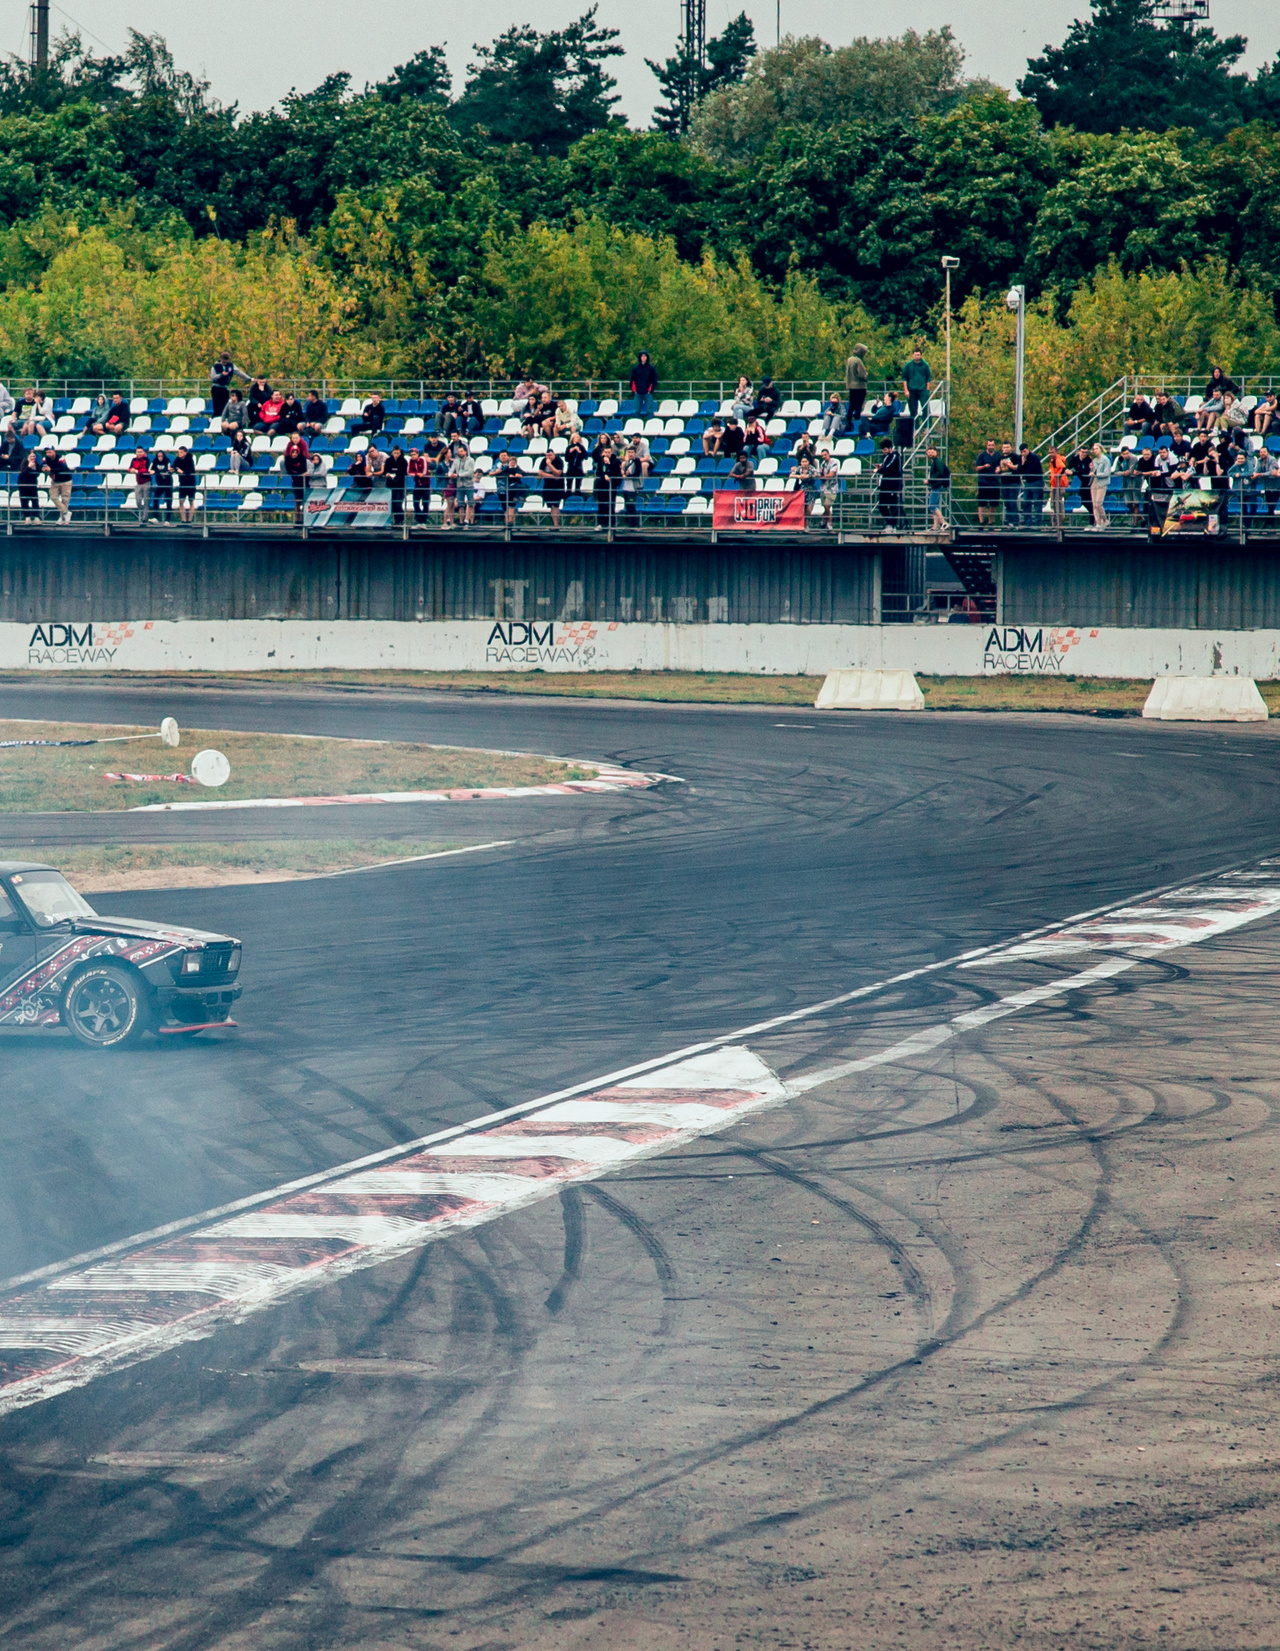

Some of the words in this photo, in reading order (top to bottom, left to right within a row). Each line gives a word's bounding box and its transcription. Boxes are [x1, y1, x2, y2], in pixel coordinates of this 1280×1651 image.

[735, 497, 757, 522] NO
[757, 497, 784, 510] DRIFT
[757, 509, 776, 522] FUN
[29, 624, 93, 647] ADM
[487, 622, 554, 646] ADM
[984, 628, 1043, 653] ADM
[28, 648, 118, 664] RACEWAY
[486, 647, 580, 663] RACEWAY
[983, 653, 1065, 670] RACEWAY
